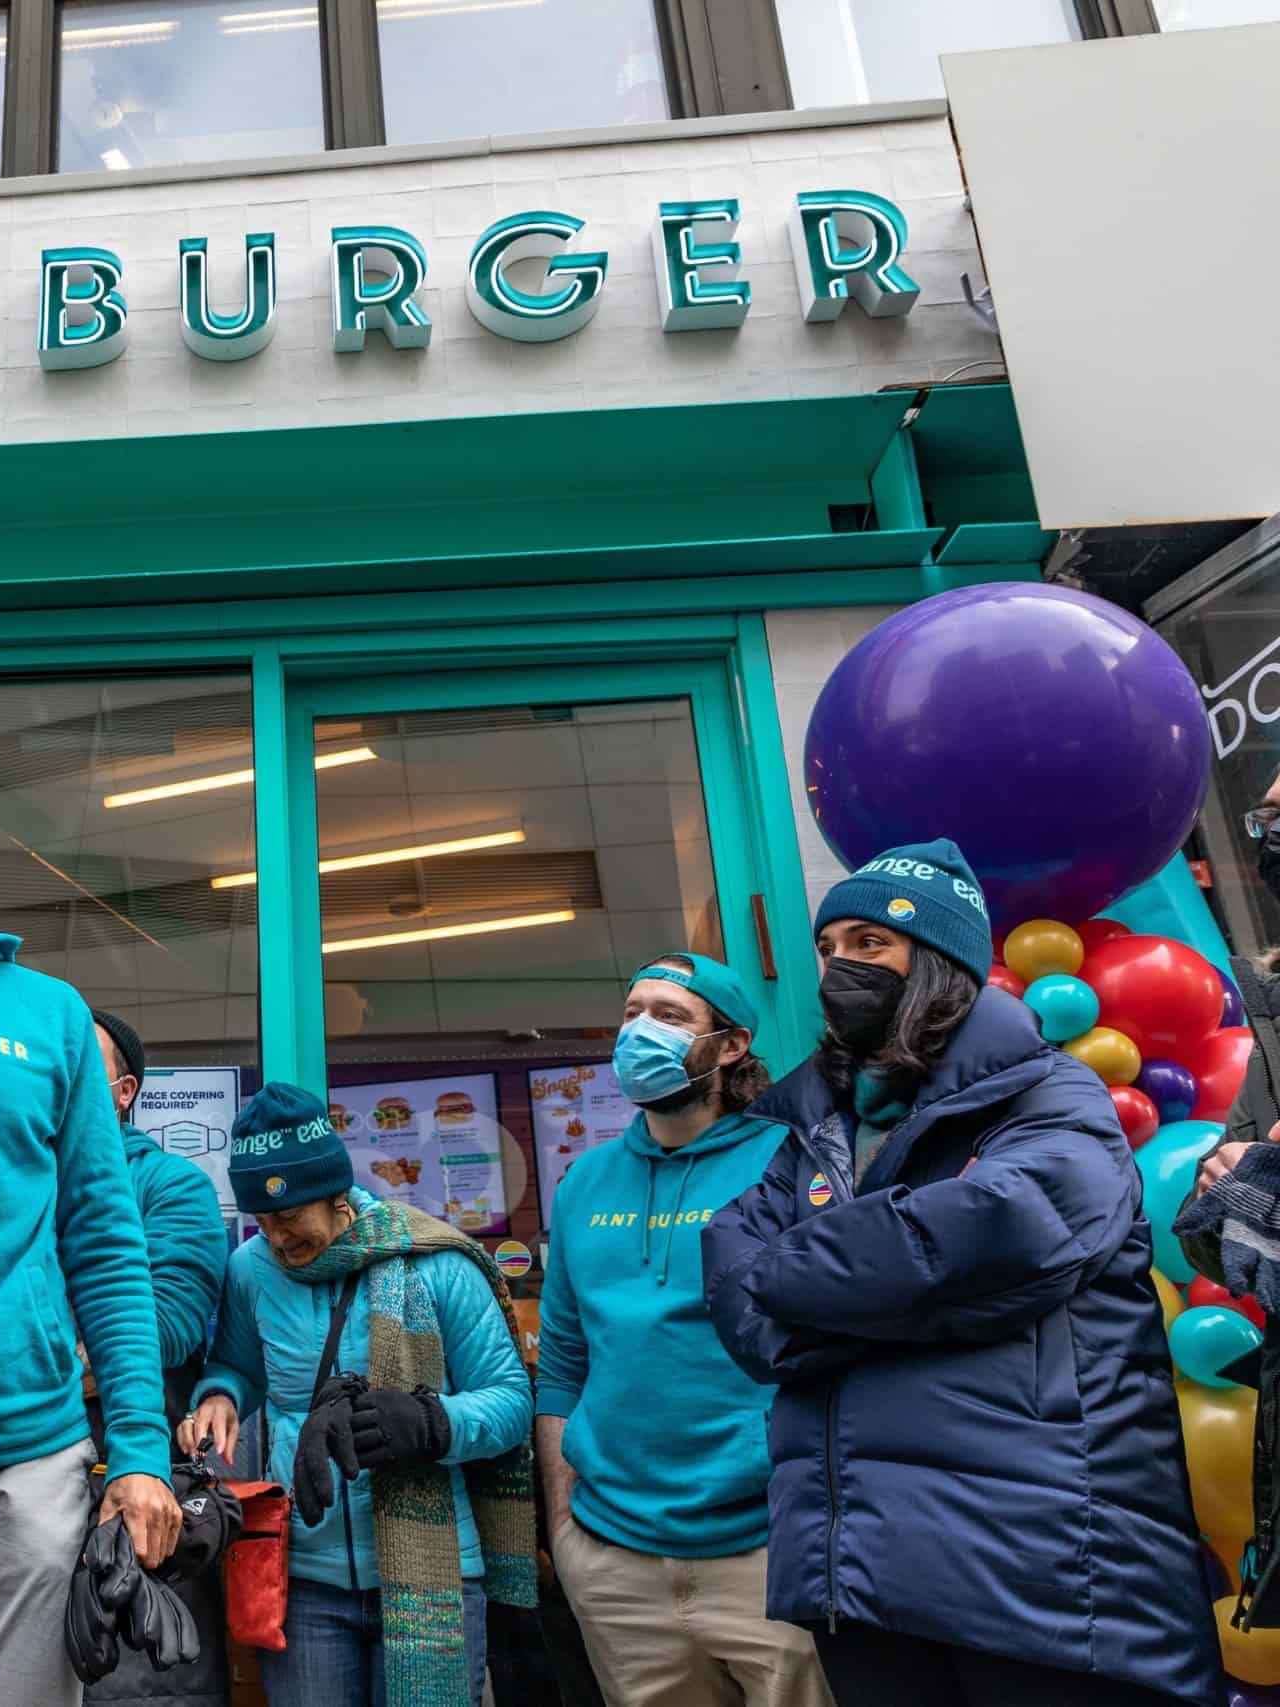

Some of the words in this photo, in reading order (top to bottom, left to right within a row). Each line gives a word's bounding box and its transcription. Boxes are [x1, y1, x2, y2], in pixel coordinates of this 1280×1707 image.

[37, 189, 921, 372] BURGER
[141, 1091, 167, 1100] FACE
[170, 1091, 225, 1100] COVERING
[590, 1213, 638, 1228] PLNT
[648, 1208, 713, 1230] BURGE
